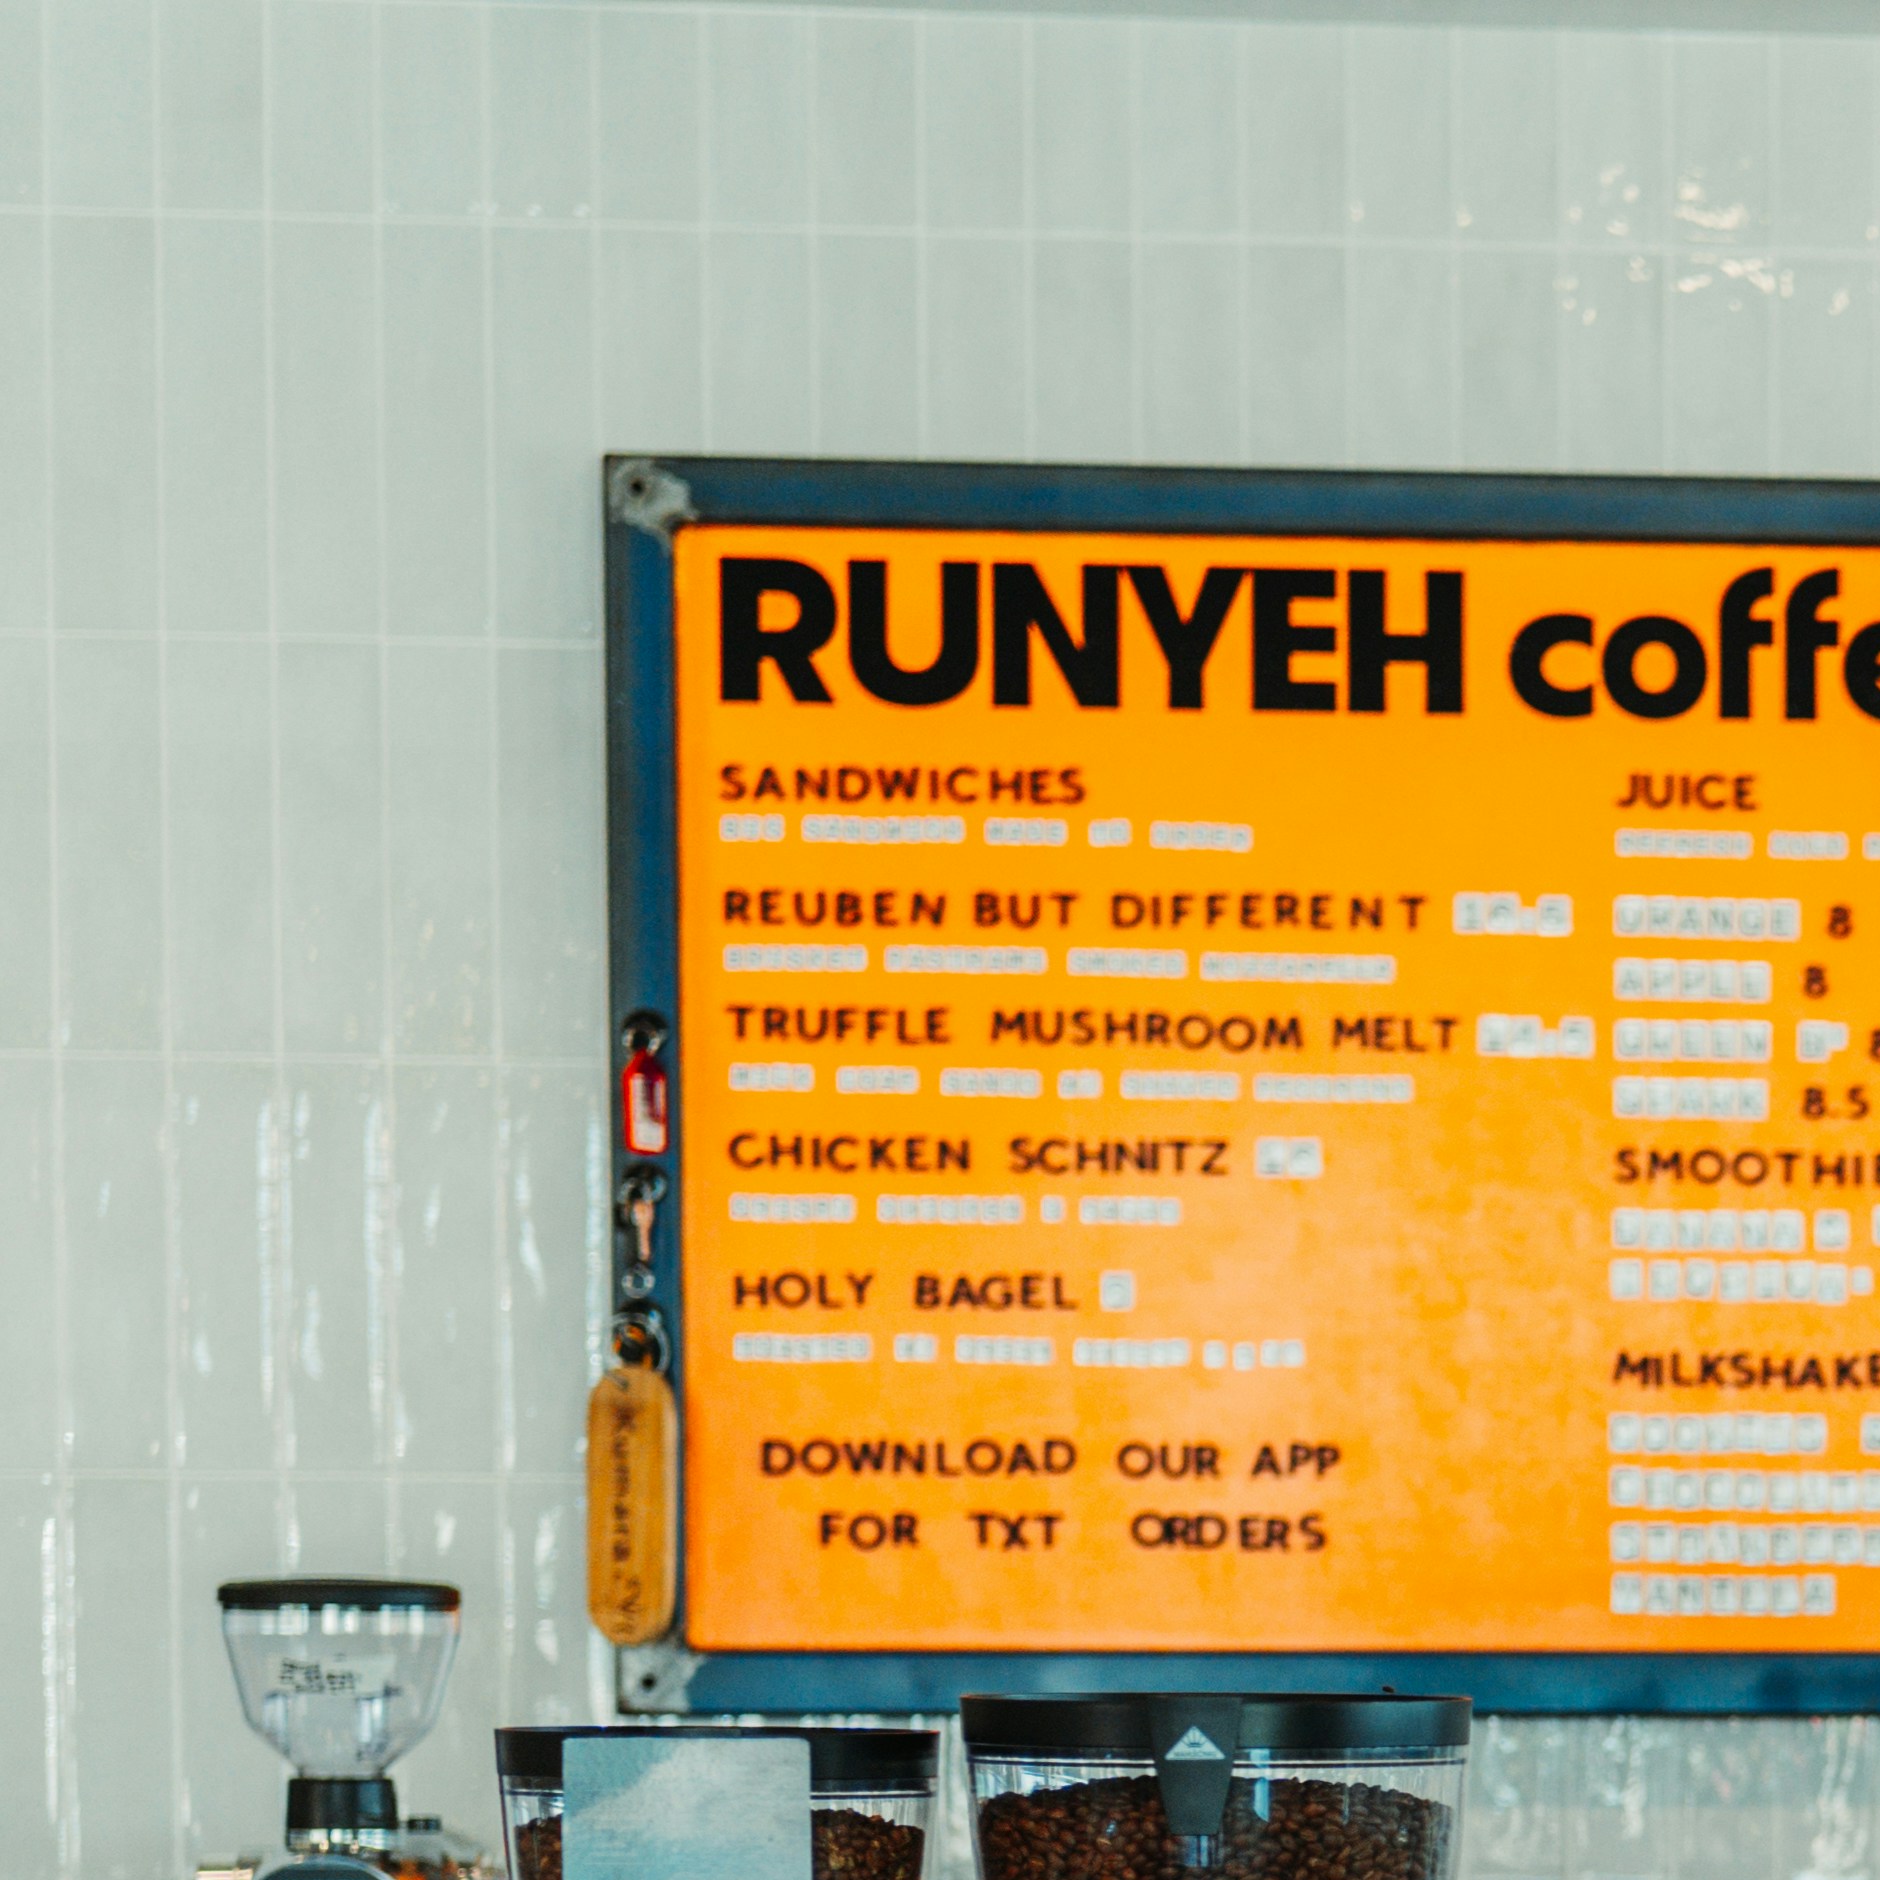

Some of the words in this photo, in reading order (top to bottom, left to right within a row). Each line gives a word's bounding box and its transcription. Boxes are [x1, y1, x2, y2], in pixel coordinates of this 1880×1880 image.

[717, 555, 1467, 716] RUNYEH
[719, 765, 1086, 805] SANDWICHES
[1619, 774, 1755, 811] JUICE
[722, 889, 947, 927] REUBEN
[973, 891, 1077, 929] BUT
[1110, 892, 1425, 930] DIFFERENT
[1827, 905, 1853, 937] 8
[1803, 965, 1828, 997] 8
[728, 1005, 946, 1044] TRUFFLE
[990, 1009, 1304, 1052] MUSHROOM
[1331, 1016, 1457, 1052] MELT
[727, 1133, 972, 1172] CHICKEN
[1008, 1137, 1229, 1175] SCHNITZ
[733, 1272, 875, 1308] HOLY
[913, 1274, 1077, 1309] BAGEL
[759, 1438, 1078, 1477] DOWNLOAD
[1116, 1442, 1221, 1479] OUR
[1249, 1442, 1342, 1478] APP
[818, 1512, 920, 1551] FOR
[969, 1512, 1061, 1550] TXT
[1129, 1512, 1328, 1552] ORDERS
